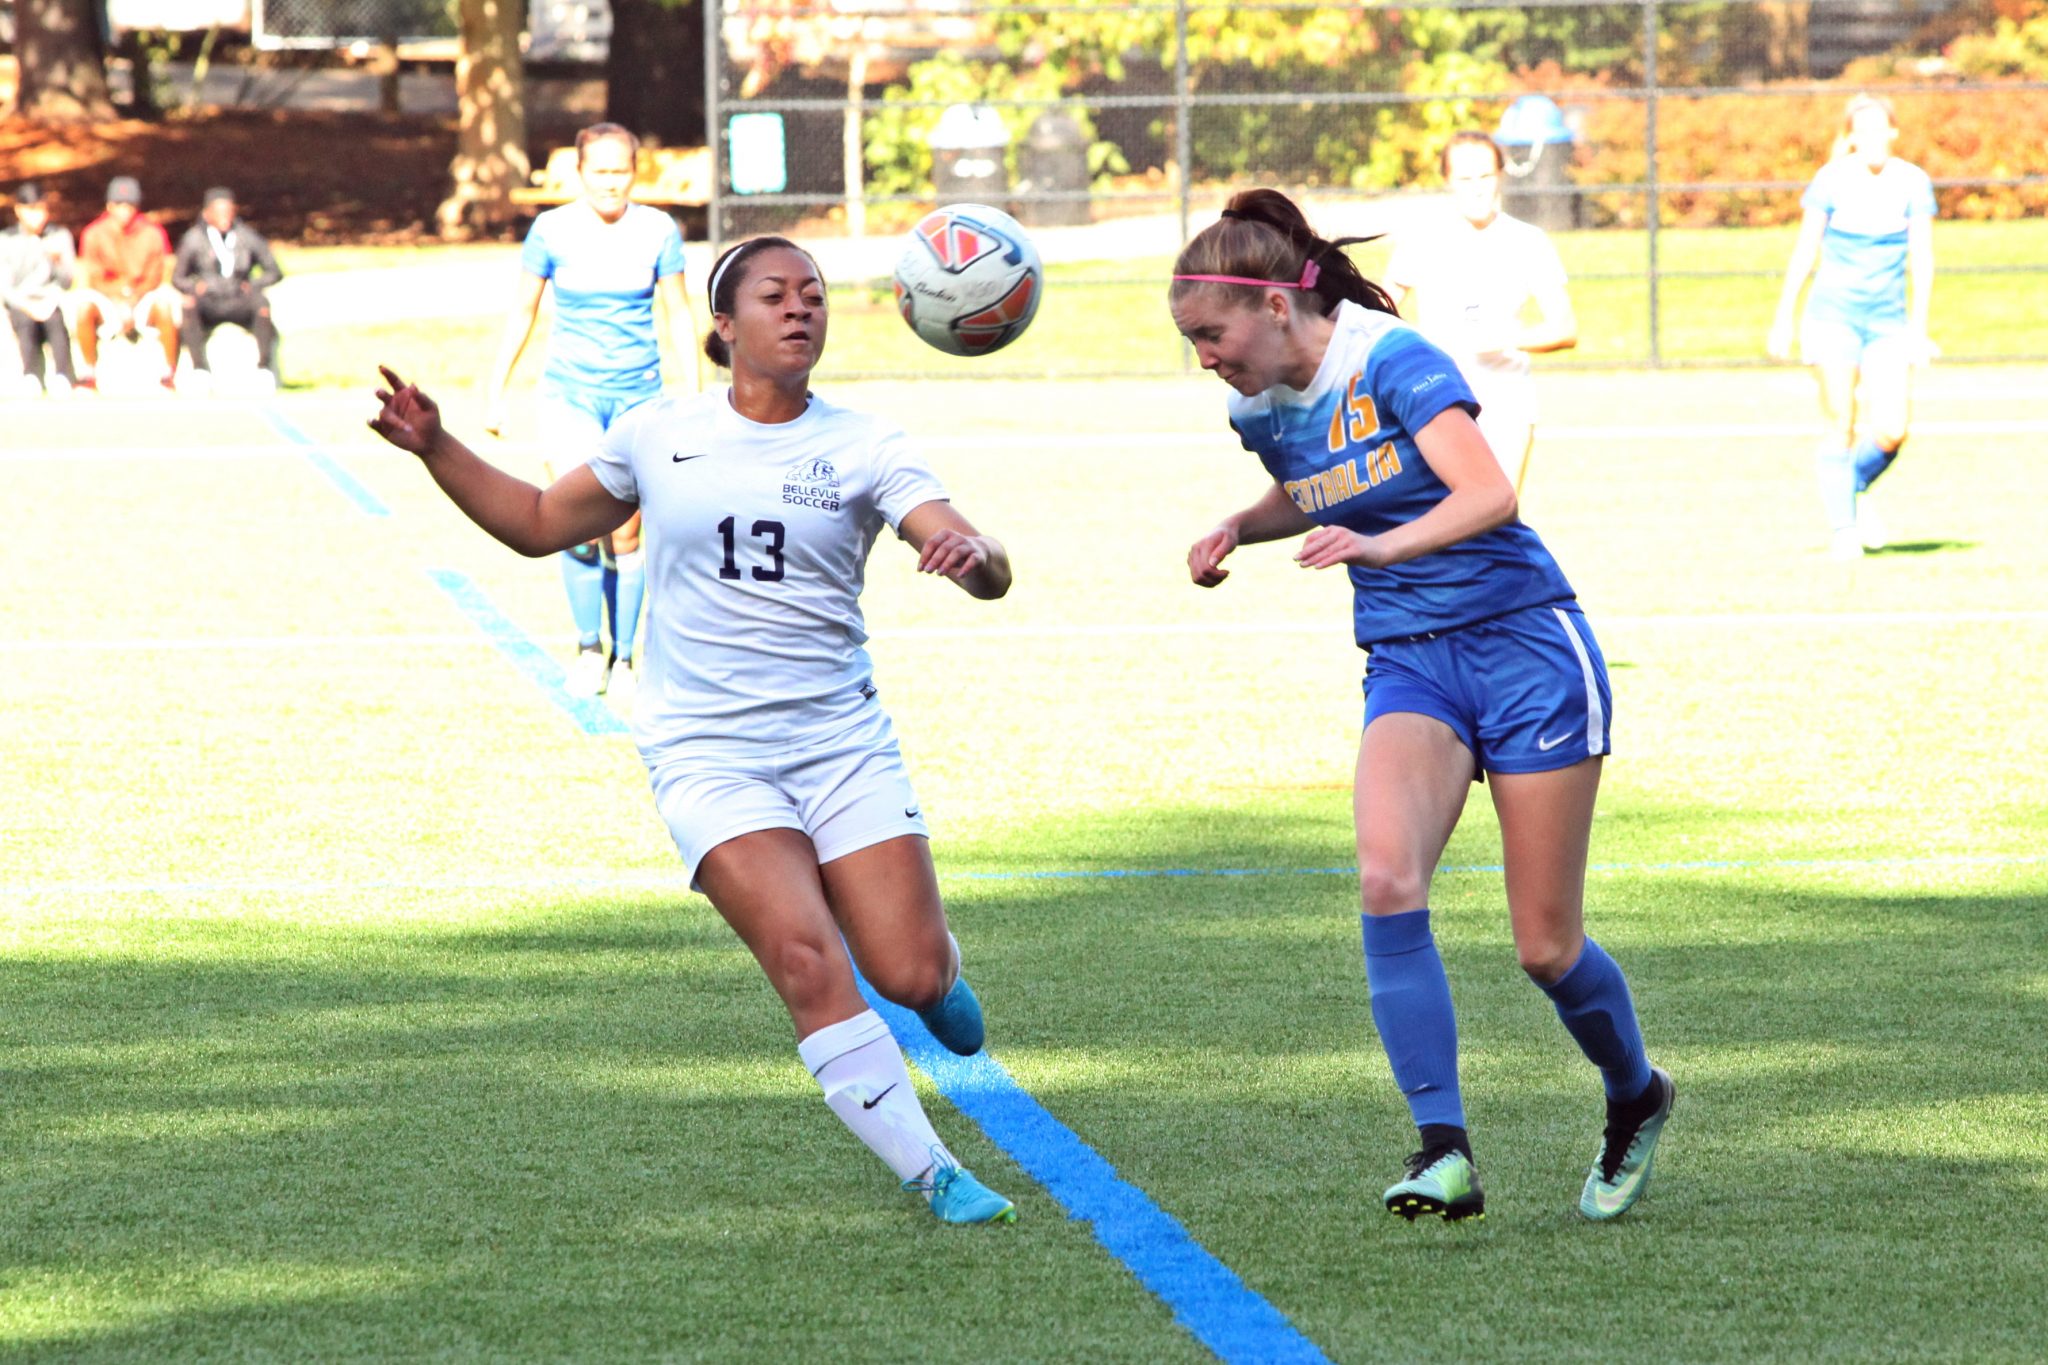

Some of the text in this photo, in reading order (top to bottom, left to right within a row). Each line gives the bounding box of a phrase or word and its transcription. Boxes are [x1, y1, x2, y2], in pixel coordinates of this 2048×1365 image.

[783, 484, 841, 500] BELLEVUE
[1283, 440, 1402, 513] CNTRALIA
[782, 494, 840, 511] SOCCER
[717, 516, 785, 582] 13
